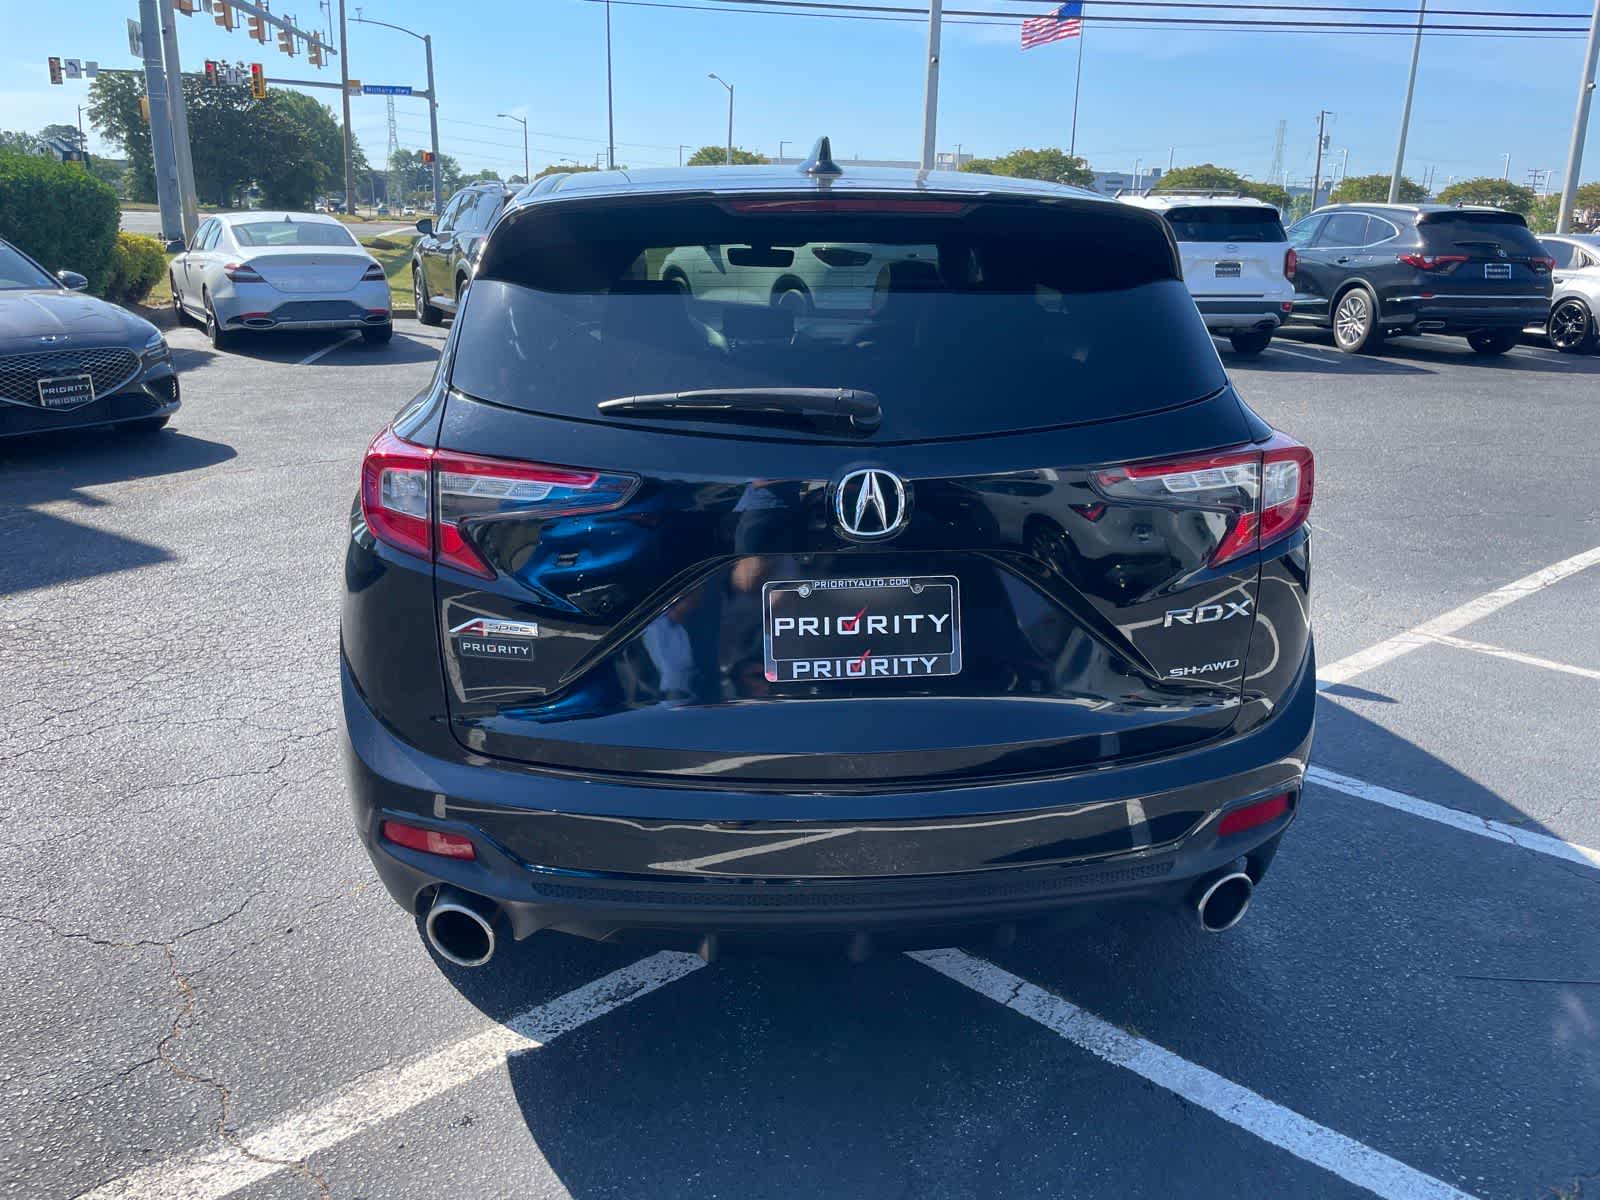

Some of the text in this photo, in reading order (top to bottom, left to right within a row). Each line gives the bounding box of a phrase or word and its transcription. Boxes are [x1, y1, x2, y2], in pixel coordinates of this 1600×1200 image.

[42, 384, 90, 394] PRIORITY
[774, 613, 950, 637] PRIORITY
[1164, 599, 1251, 628] RDX
[462, 642, 529, 655] PRIORITY
[792, 656, 938, 679] PRIORITY
